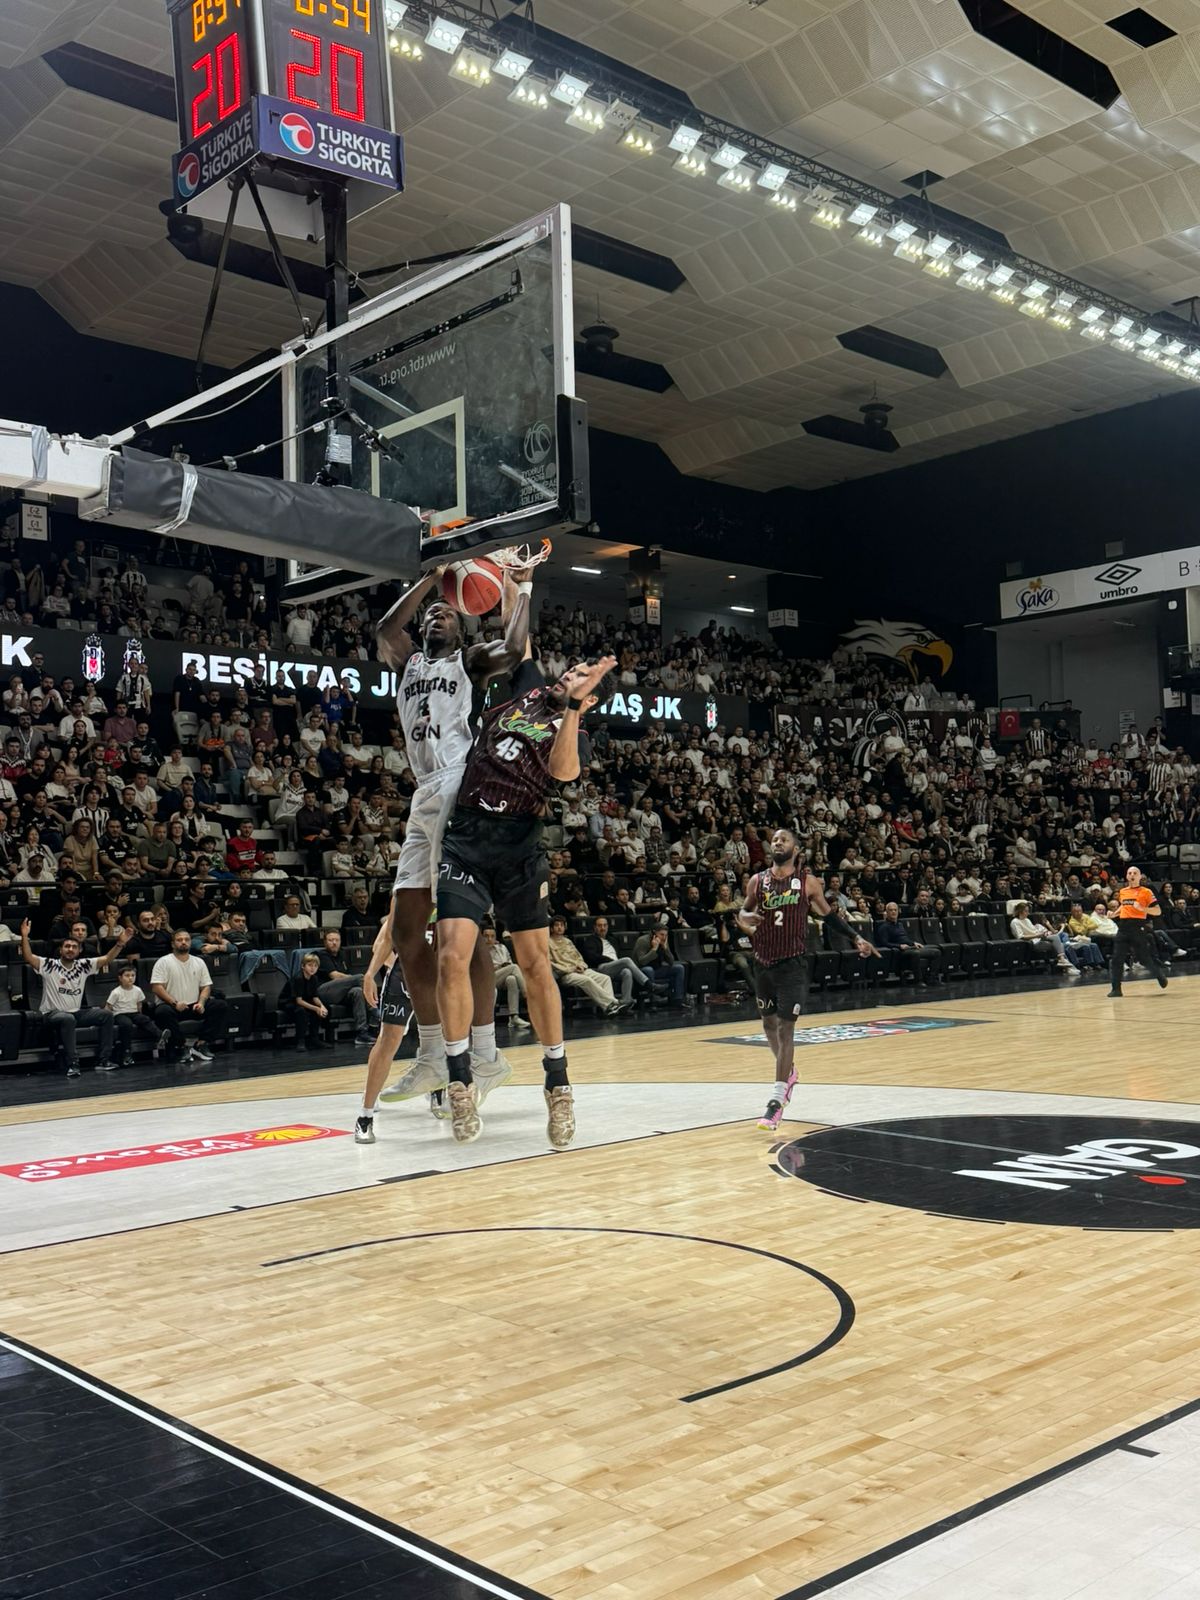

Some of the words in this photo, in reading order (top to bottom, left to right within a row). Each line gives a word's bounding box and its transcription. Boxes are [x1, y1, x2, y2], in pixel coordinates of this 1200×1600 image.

[192, 33, 241, 139] 20
[288, 28, 365, 122] 20
[316, 122, 392, 160] TÜRKİYE
[318, 142, 394, 179] SİGORTA
[1100, 585, 1138, 600] umbro
[649, 695, 682, 720] JK
[494, 736, 524, 761] 45
[774, 910, 784, 926] 2
